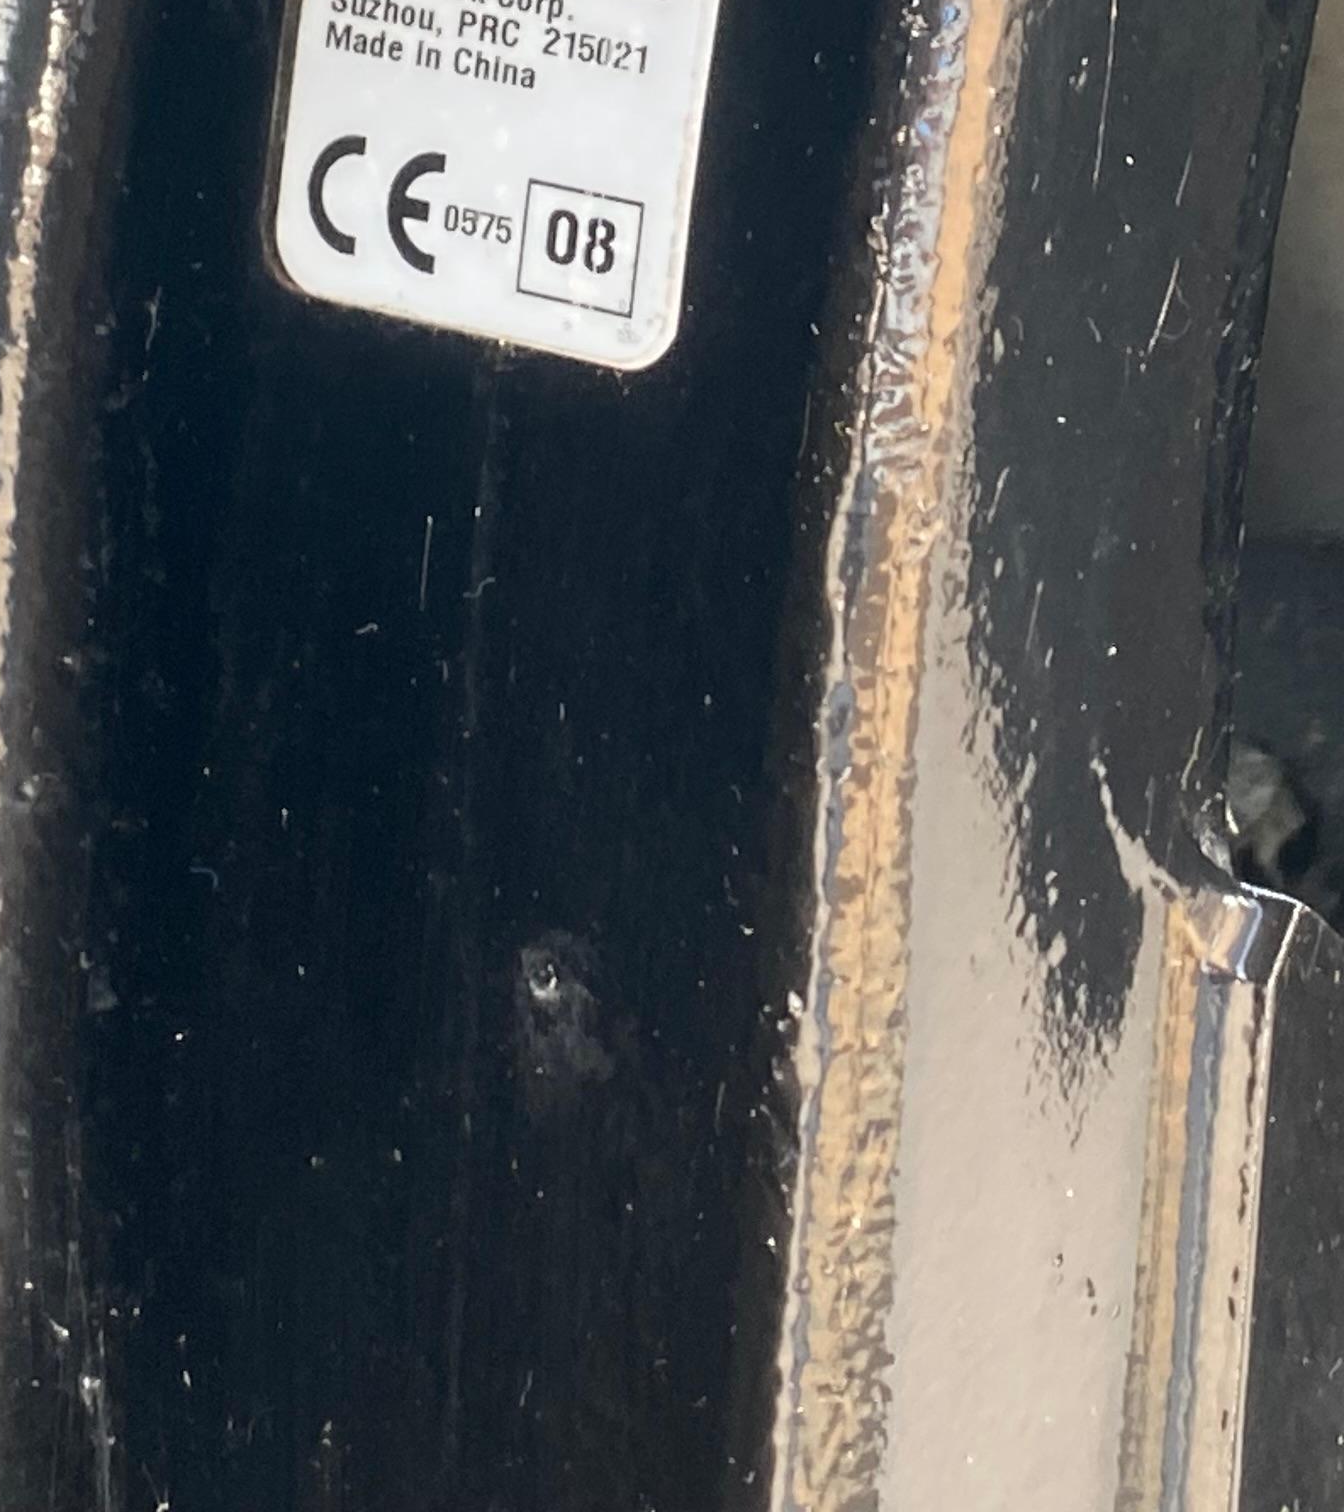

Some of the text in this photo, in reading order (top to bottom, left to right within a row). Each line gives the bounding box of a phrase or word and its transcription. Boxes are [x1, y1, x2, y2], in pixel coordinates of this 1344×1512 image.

[325, 21, 536, 89] Made in China
[458, 10, 520, 47] PRC
[542, 27, 648, 73] 215021
[547, 209, 617, 275] 08
